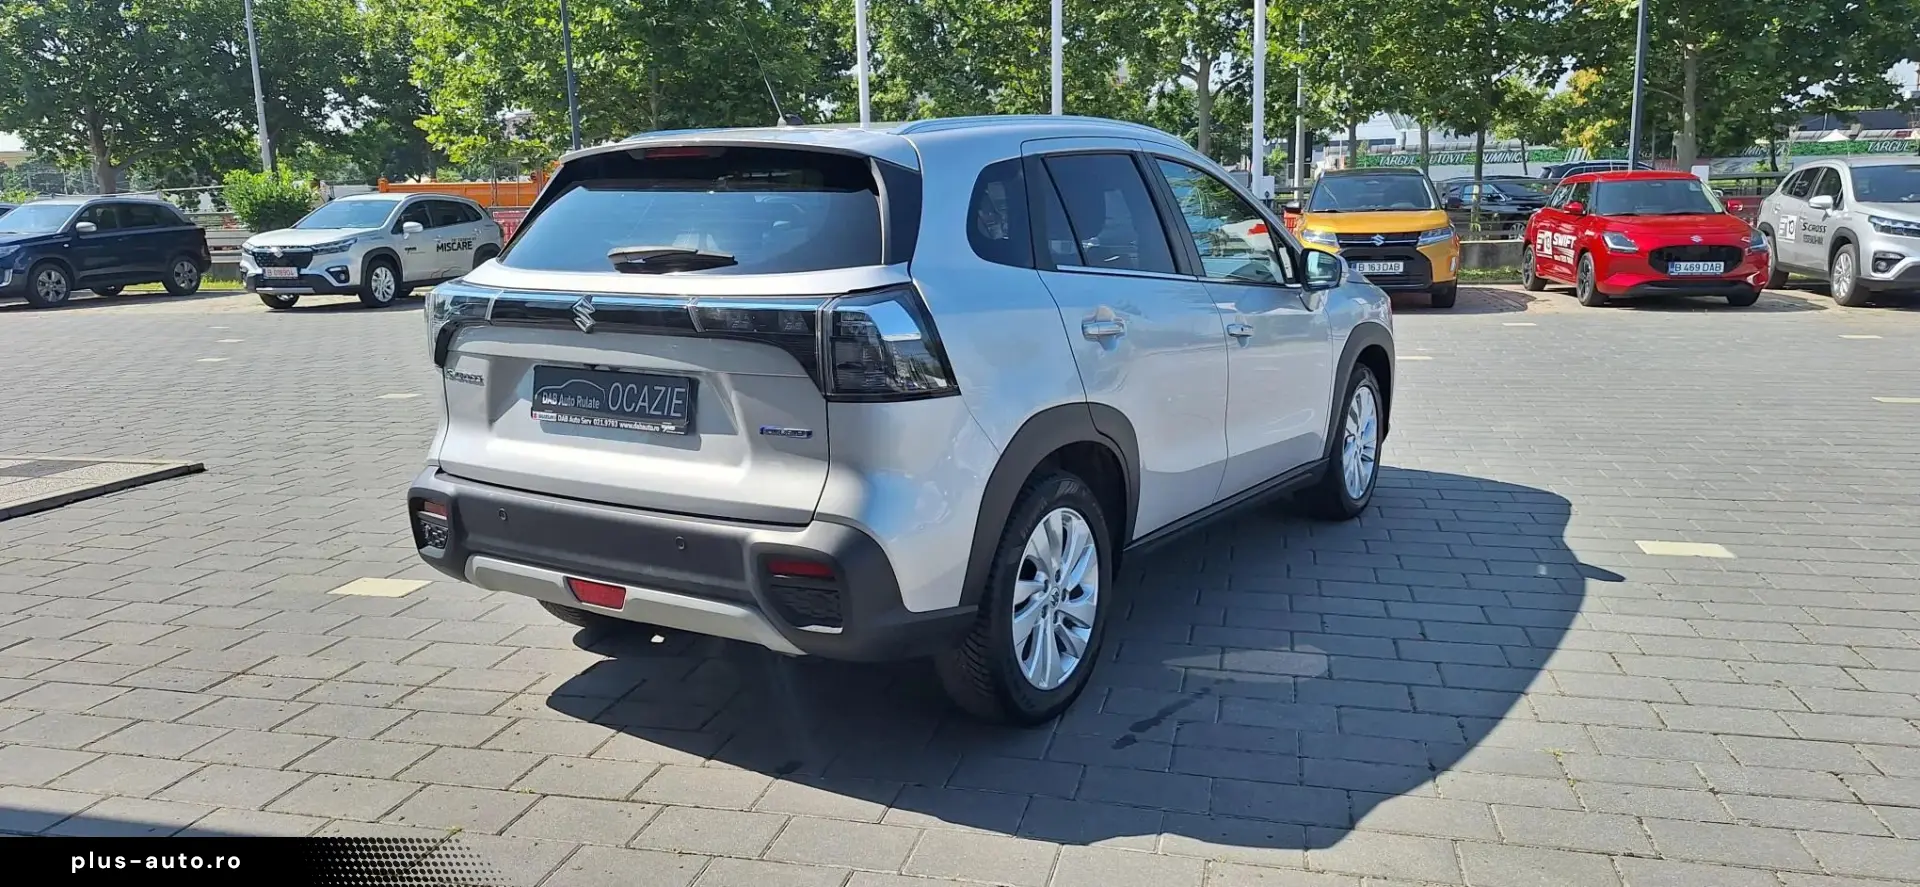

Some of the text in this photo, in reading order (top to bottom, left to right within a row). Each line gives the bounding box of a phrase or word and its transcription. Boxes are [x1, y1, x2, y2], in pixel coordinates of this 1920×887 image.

[1867, 140, 1911, 153] TARGUL
[1379, 151, 1529, 167] TARGUL UTOVIT UMINICA
[436, 241, 473, 253] MISCARE
[1552, 232, 1577, 249] SWIFT
[1358, 263, 1365, 272] B
[1382, 262, 1401, 271] DAB
[1674, 262, 1722, 272] B 469 DAB
[541, 391, 600, 410] DAB Auto Rulate
[608, 382, 686, 417] OCAZIE
[557, 414, 569, 423] DAB
[569, 416, 580, 425] Auto
[581, 417, 592, 426] Serv
